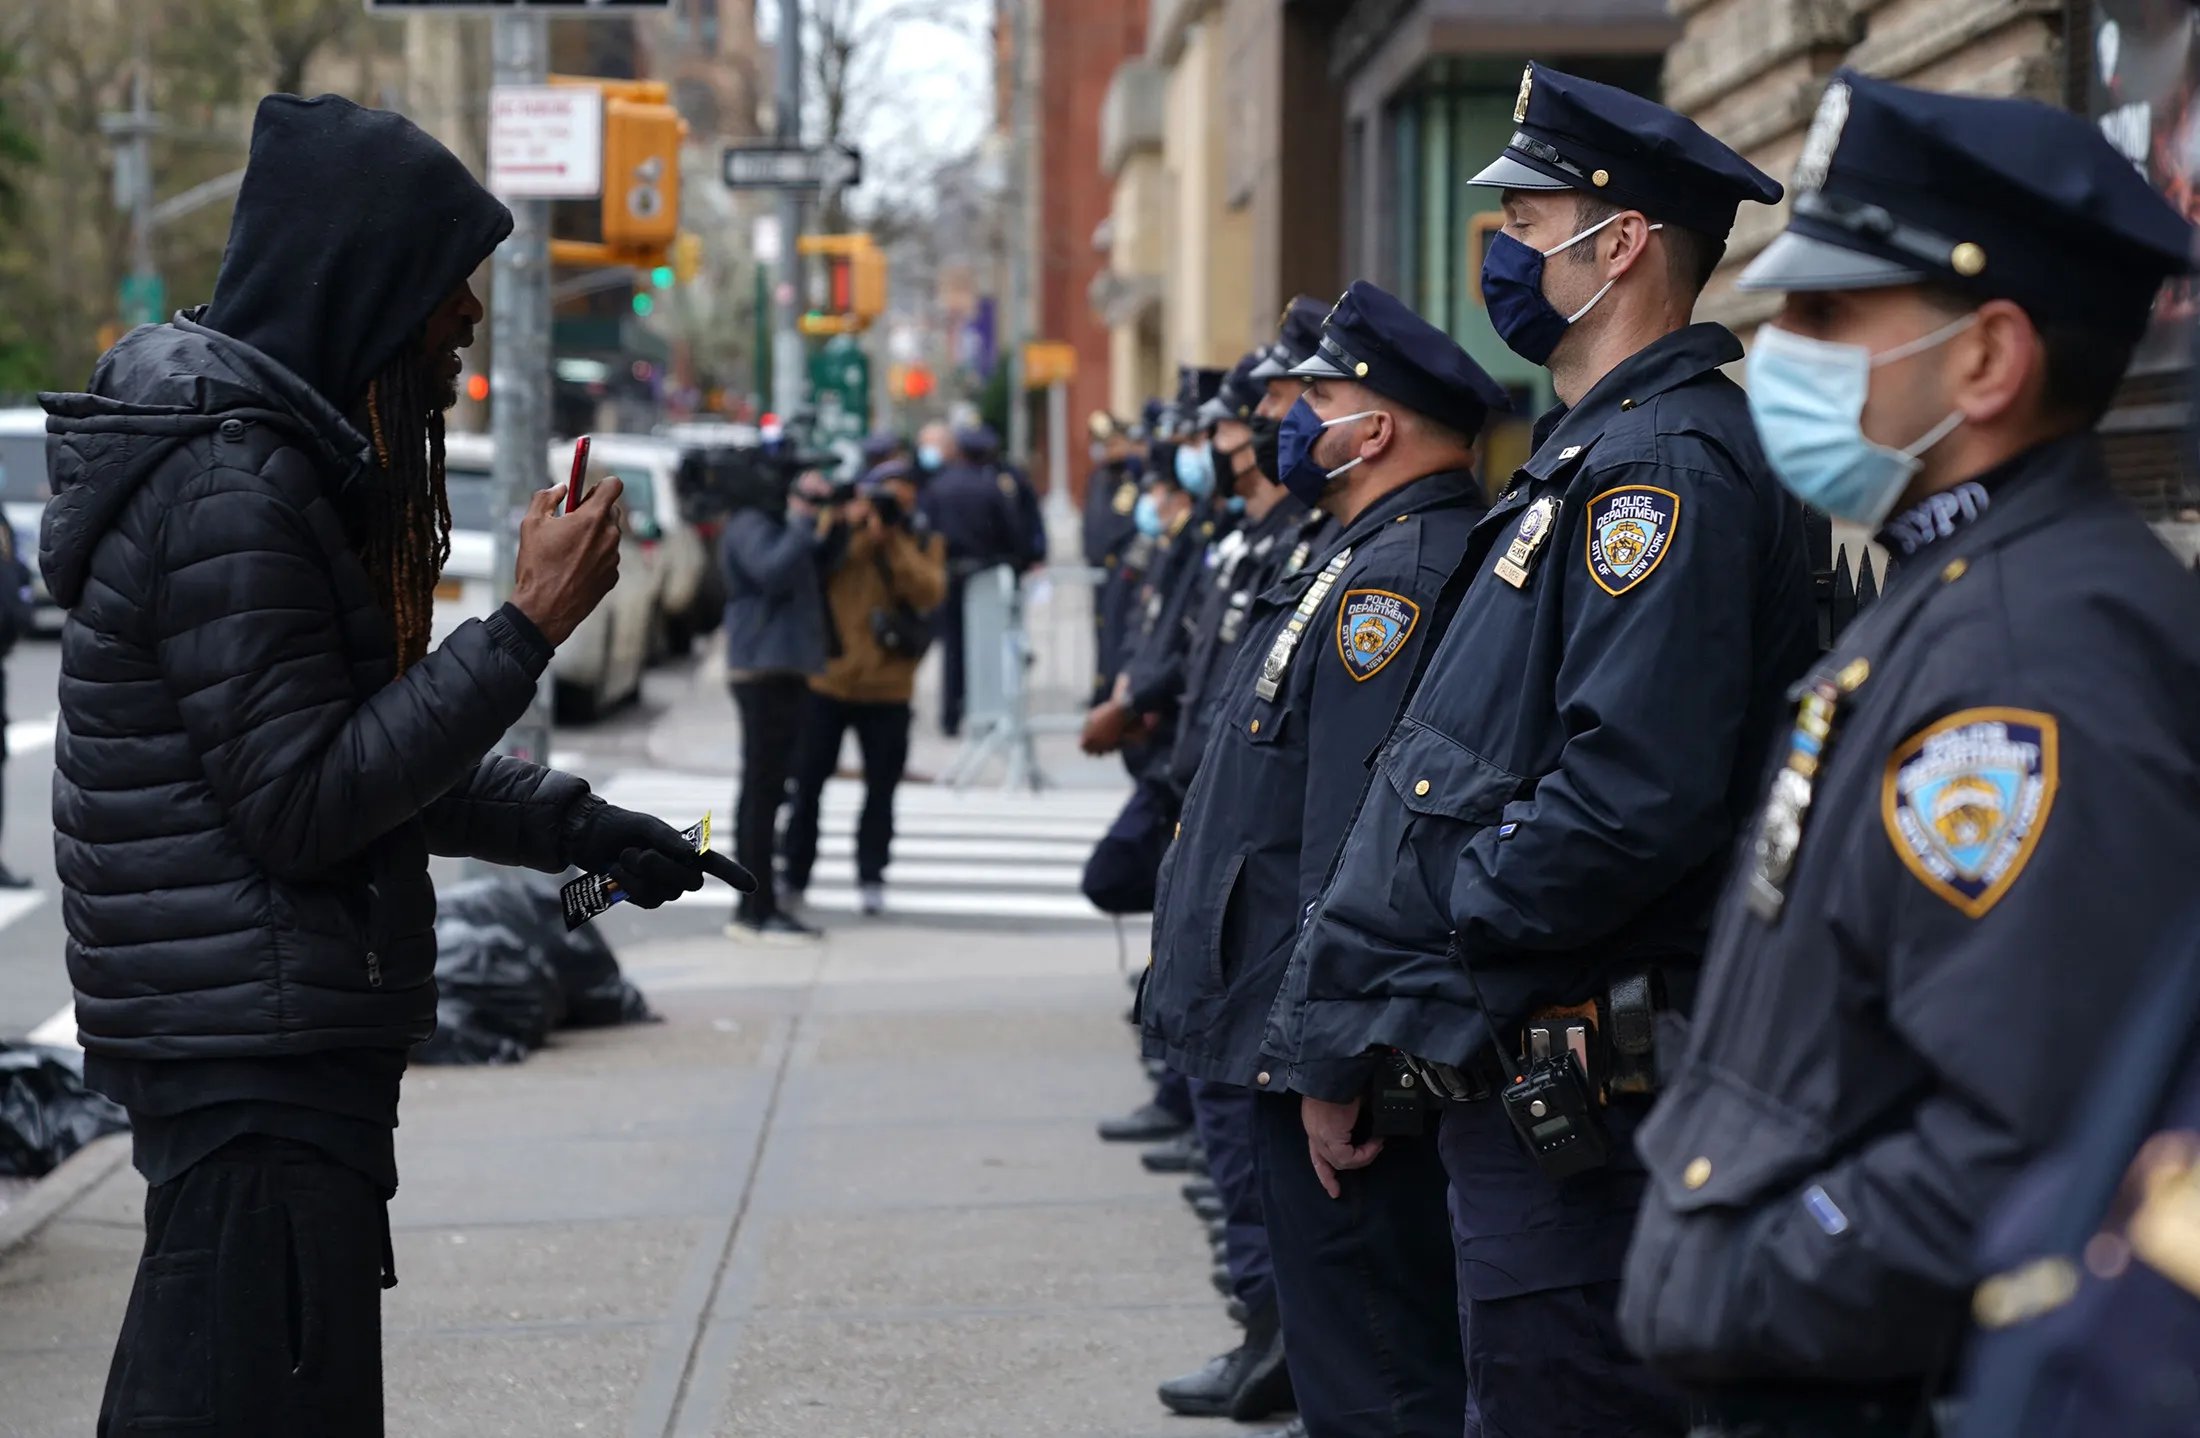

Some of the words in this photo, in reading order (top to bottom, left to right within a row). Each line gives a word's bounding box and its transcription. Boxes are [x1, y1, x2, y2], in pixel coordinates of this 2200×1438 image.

[1611, 495, 1653, 510] POLICE
[1596, 507, 1666, 530] DEPARTMENT
[1592, 540, 1602, 561] CITY
[1598, 563, 1611, 575] OF
[1628, 559, 1648, 580] NEW
[1645, 532, 1666, 558] YORK
[1365, 594, 1401, 610] POLICE
[1347, 604, 1410, 625] DEPARTMENT
[1342, 625, 1350, 646] CITY
[1345, 649, 1355, 661] OF
[1366, 654, 1384, 671] NEW
[1384, 631, 1405, 654] YORK
